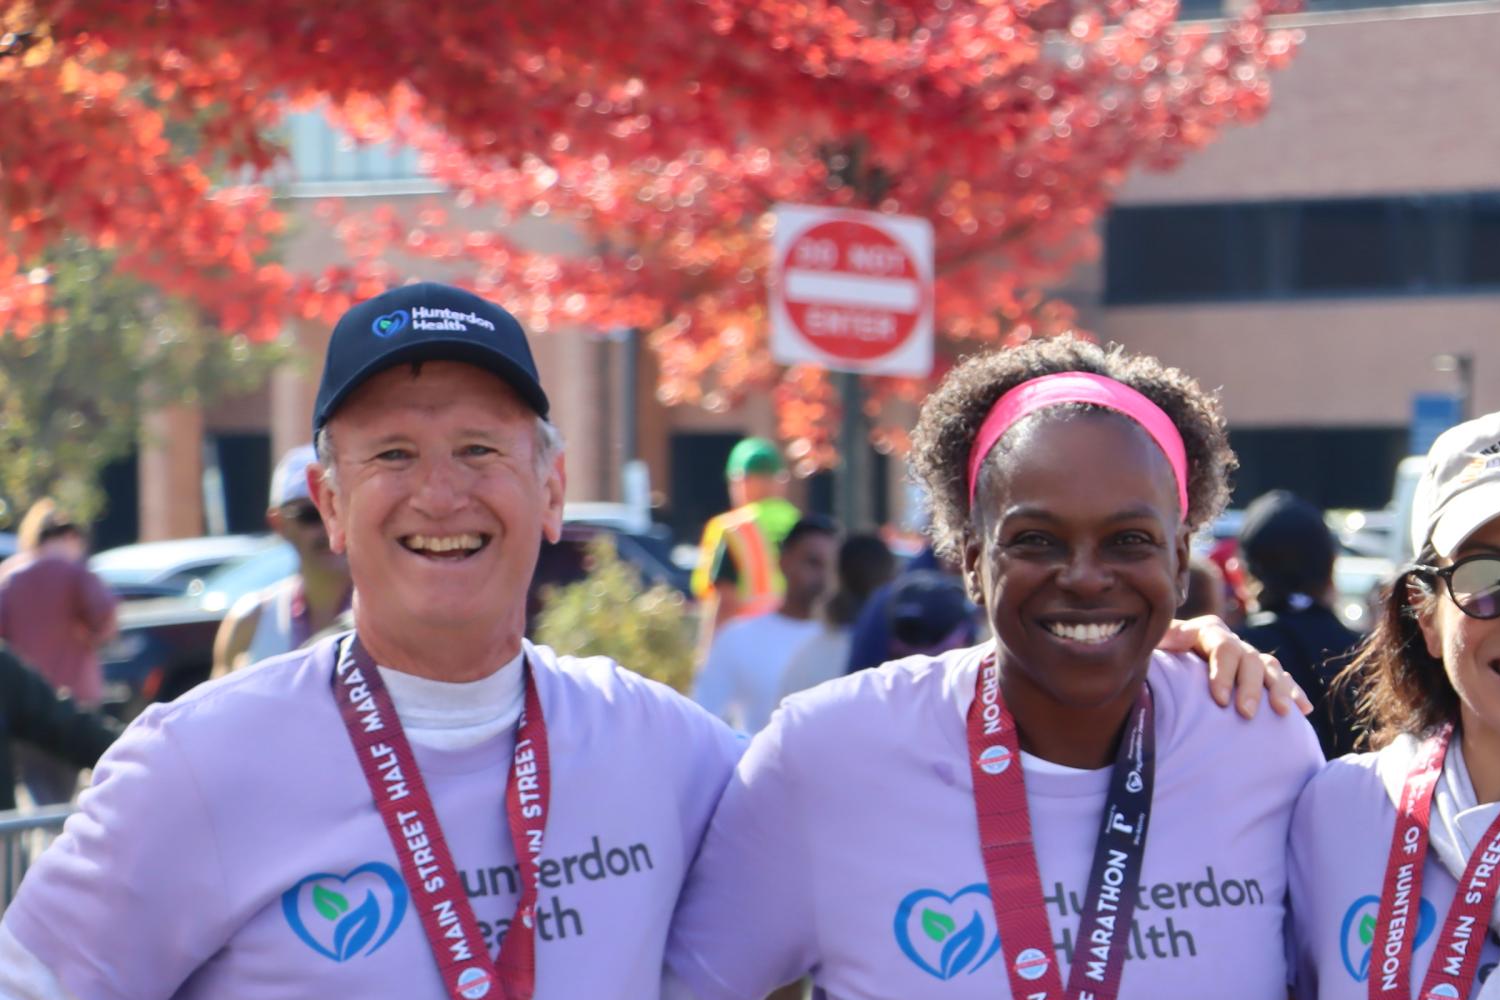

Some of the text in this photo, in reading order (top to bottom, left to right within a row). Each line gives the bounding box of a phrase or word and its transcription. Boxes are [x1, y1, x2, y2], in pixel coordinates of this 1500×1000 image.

[794, 238, 905, 276] DO NOT
[412, 307, 495, 331] Hunterdon
[412, 320, 467, 332] Health
[804, 307, 897, 342] ENTER
[370, 743, 411, 801] HALF
[514, 739, 542, 819] STREET
[397, 810, 445, 893] STREET
[1403, 826, 1420, 854] OF
[433, 900, 474, 962] MAIN
[1086, 850, 1129, 981] MARATHON
[1382, 863, 1413, 991] HUNTERDON
[1443, 915, 1475, 976] MAIN
